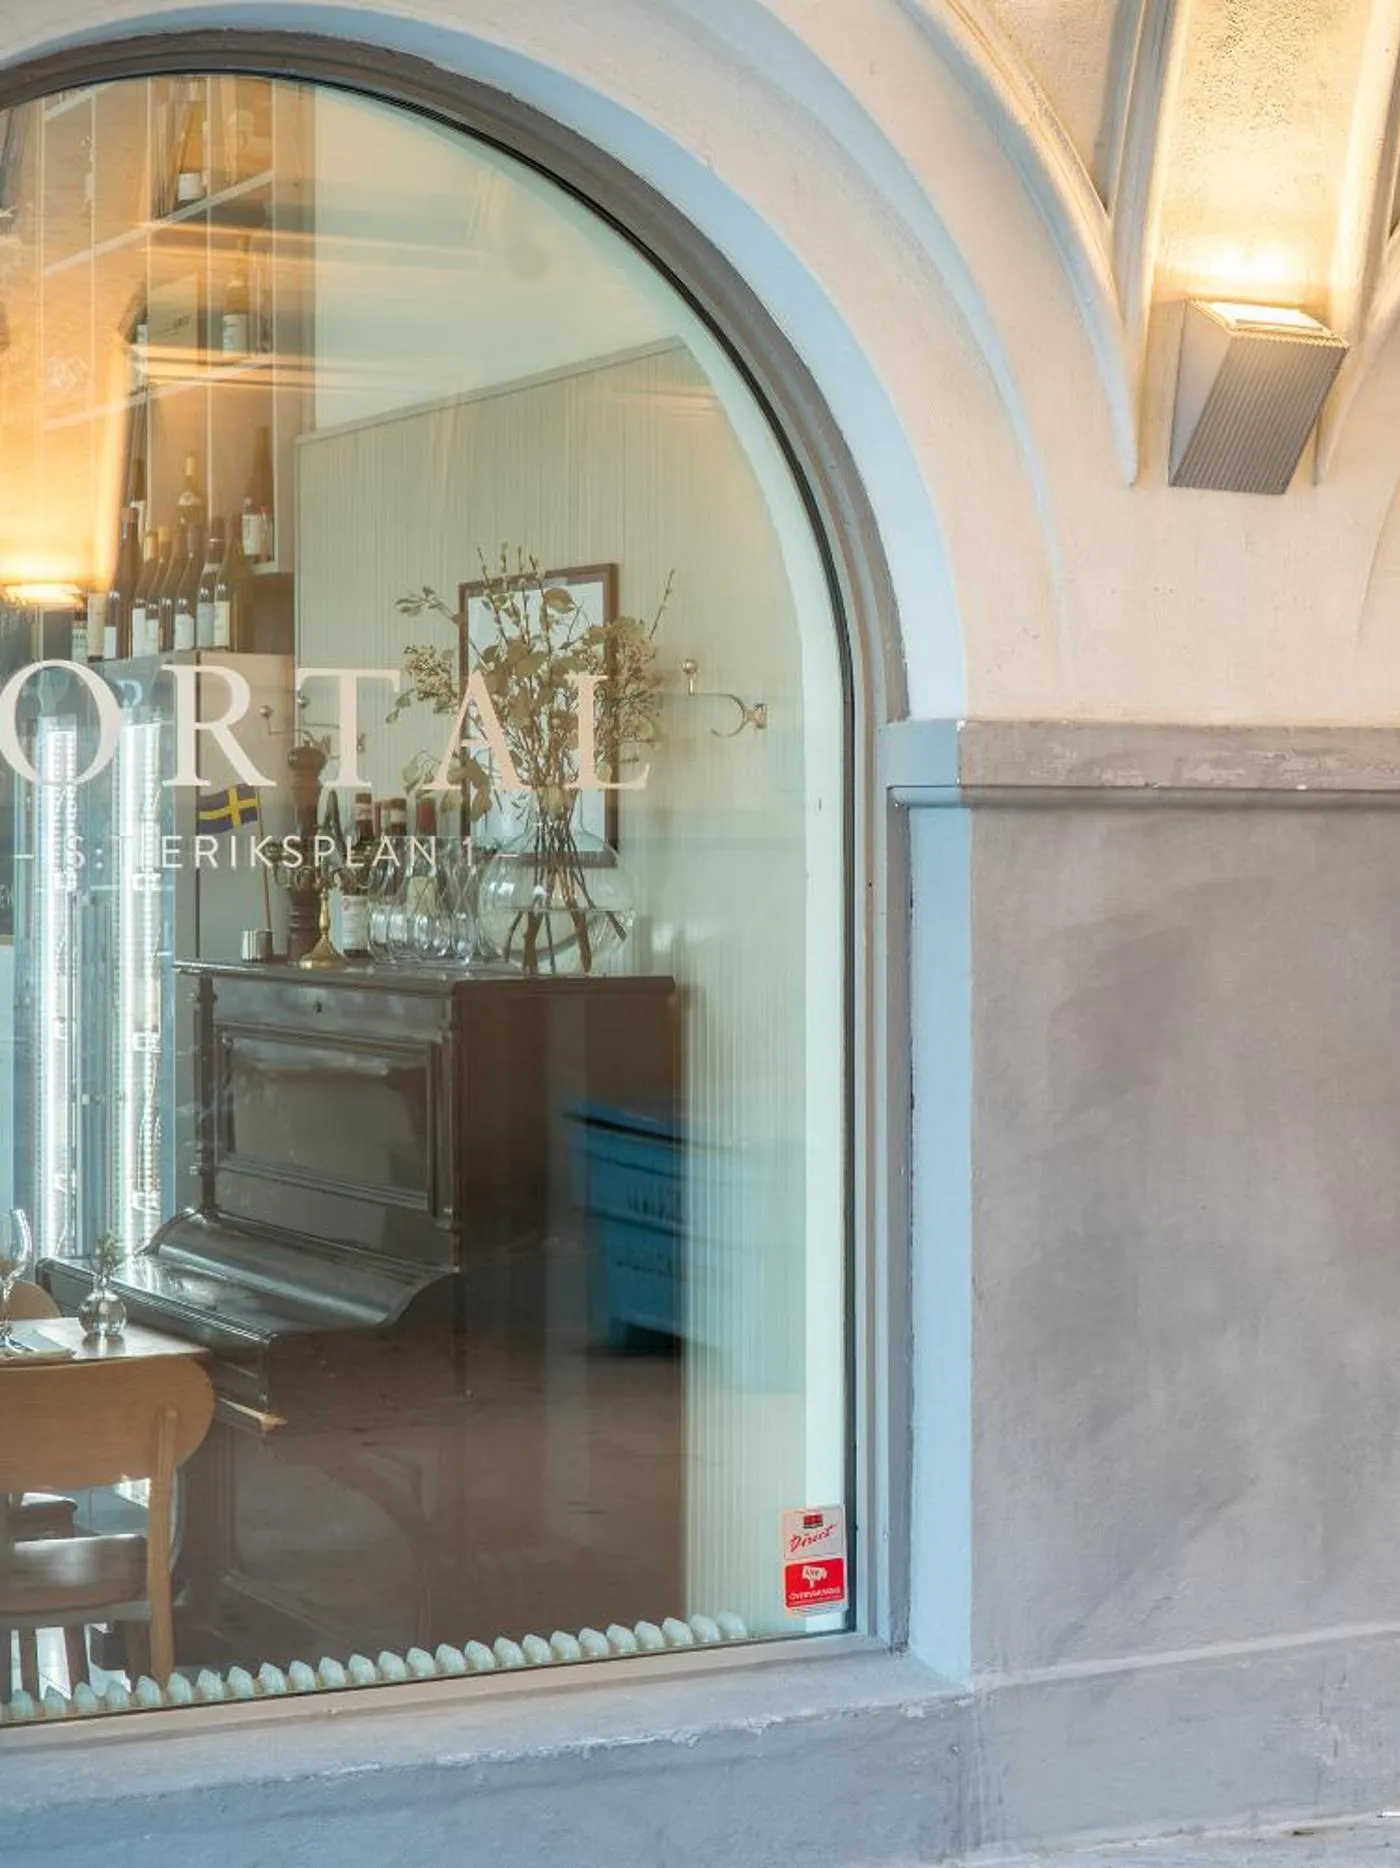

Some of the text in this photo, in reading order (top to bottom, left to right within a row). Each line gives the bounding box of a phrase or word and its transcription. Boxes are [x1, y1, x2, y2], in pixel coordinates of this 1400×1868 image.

[0, 659, 650, 791] ORTAL
[160, 834, 437, 869] ERIKSPLAN
[461, 835, 474, 867] 1
